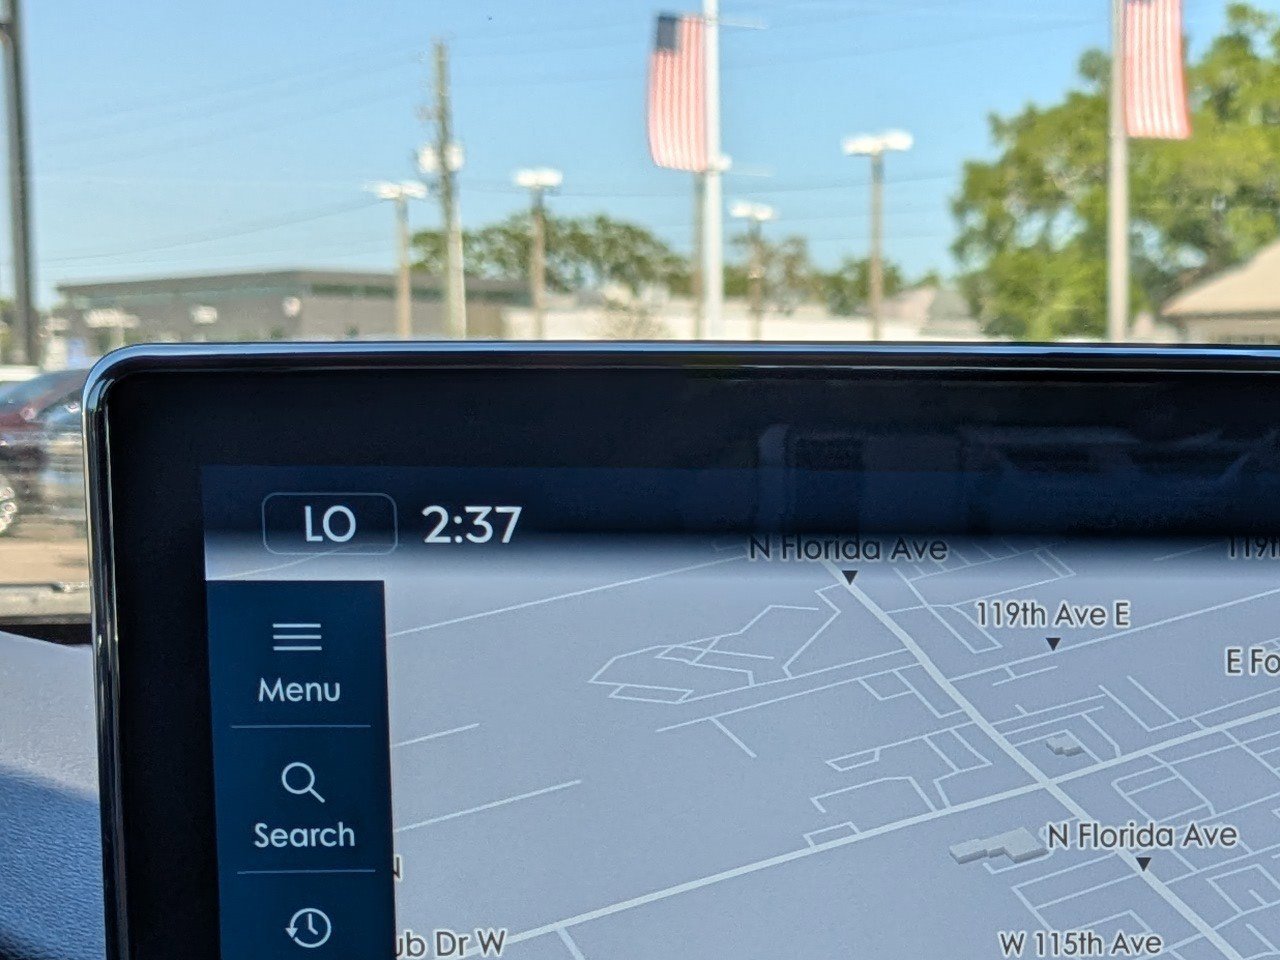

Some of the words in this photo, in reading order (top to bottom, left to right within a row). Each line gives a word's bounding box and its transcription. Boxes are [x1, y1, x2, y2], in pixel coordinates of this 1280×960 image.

[304, 504, 357, 543] LO
[421, 504, 523, 545] 2:37
[750, 536, 770, 560] N
[781, 534, 881, 561] Florida
[891, 537, 949, 561] Ave
[977, 601, 1046, 626] 119th
[1054, 603, 1107, 627] Ave
[1115, 602, 1129, 626] E
[1226, 649, 1241, 674] E
[257, 676, 342, 703] Menu
[253, 820, 356, 849] Search
[1048, 824, 1069, 849] N
[1078, 821, 1175, 849] Florida
[1182, 823, 1238, 848] Ave
[436, 931, 468, 956] Dr
[477, 930, 505, 955] W
[1000, 932, 1025, 955] W
[1035, 931, 1103, 956] 115th
[1111, 932, 1163, 955] Ave
